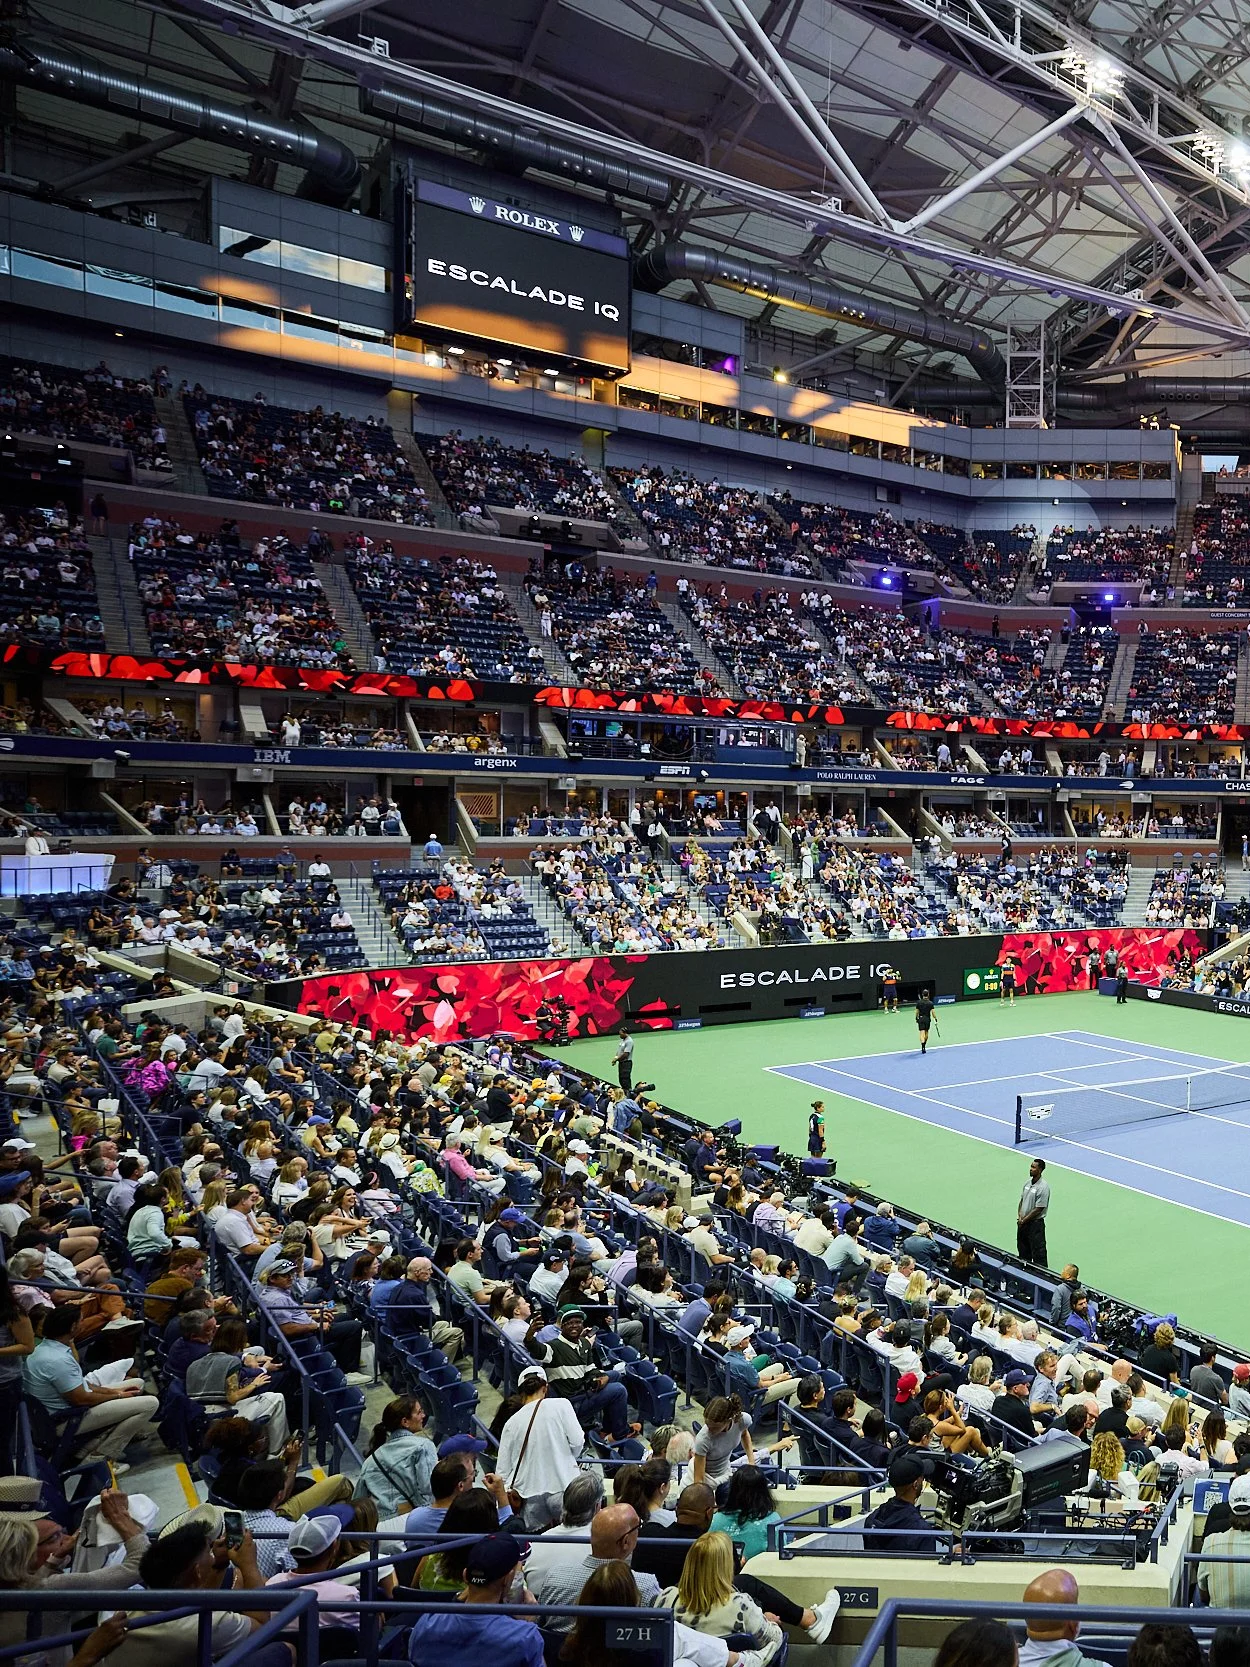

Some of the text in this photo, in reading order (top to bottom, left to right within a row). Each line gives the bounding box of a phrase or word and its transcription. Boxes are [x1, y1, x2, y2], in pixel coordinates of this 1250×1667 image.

[495, 205, 560, 235] ROLEX
[427, 258, 620, 322] ESCALADE IQ
[254, 750, 291, 764] IBM
[474, 757, 517, 769] argenx
[660, 765, 691, 776] ESPN
[816, 771, 877, 781] POLO RALPH LAUREN
[720, 965, 861, 988] ESCALADE
[843, 1592, 869, 1603] 27 G
[616, 1627, 651, 1642] 27 H
